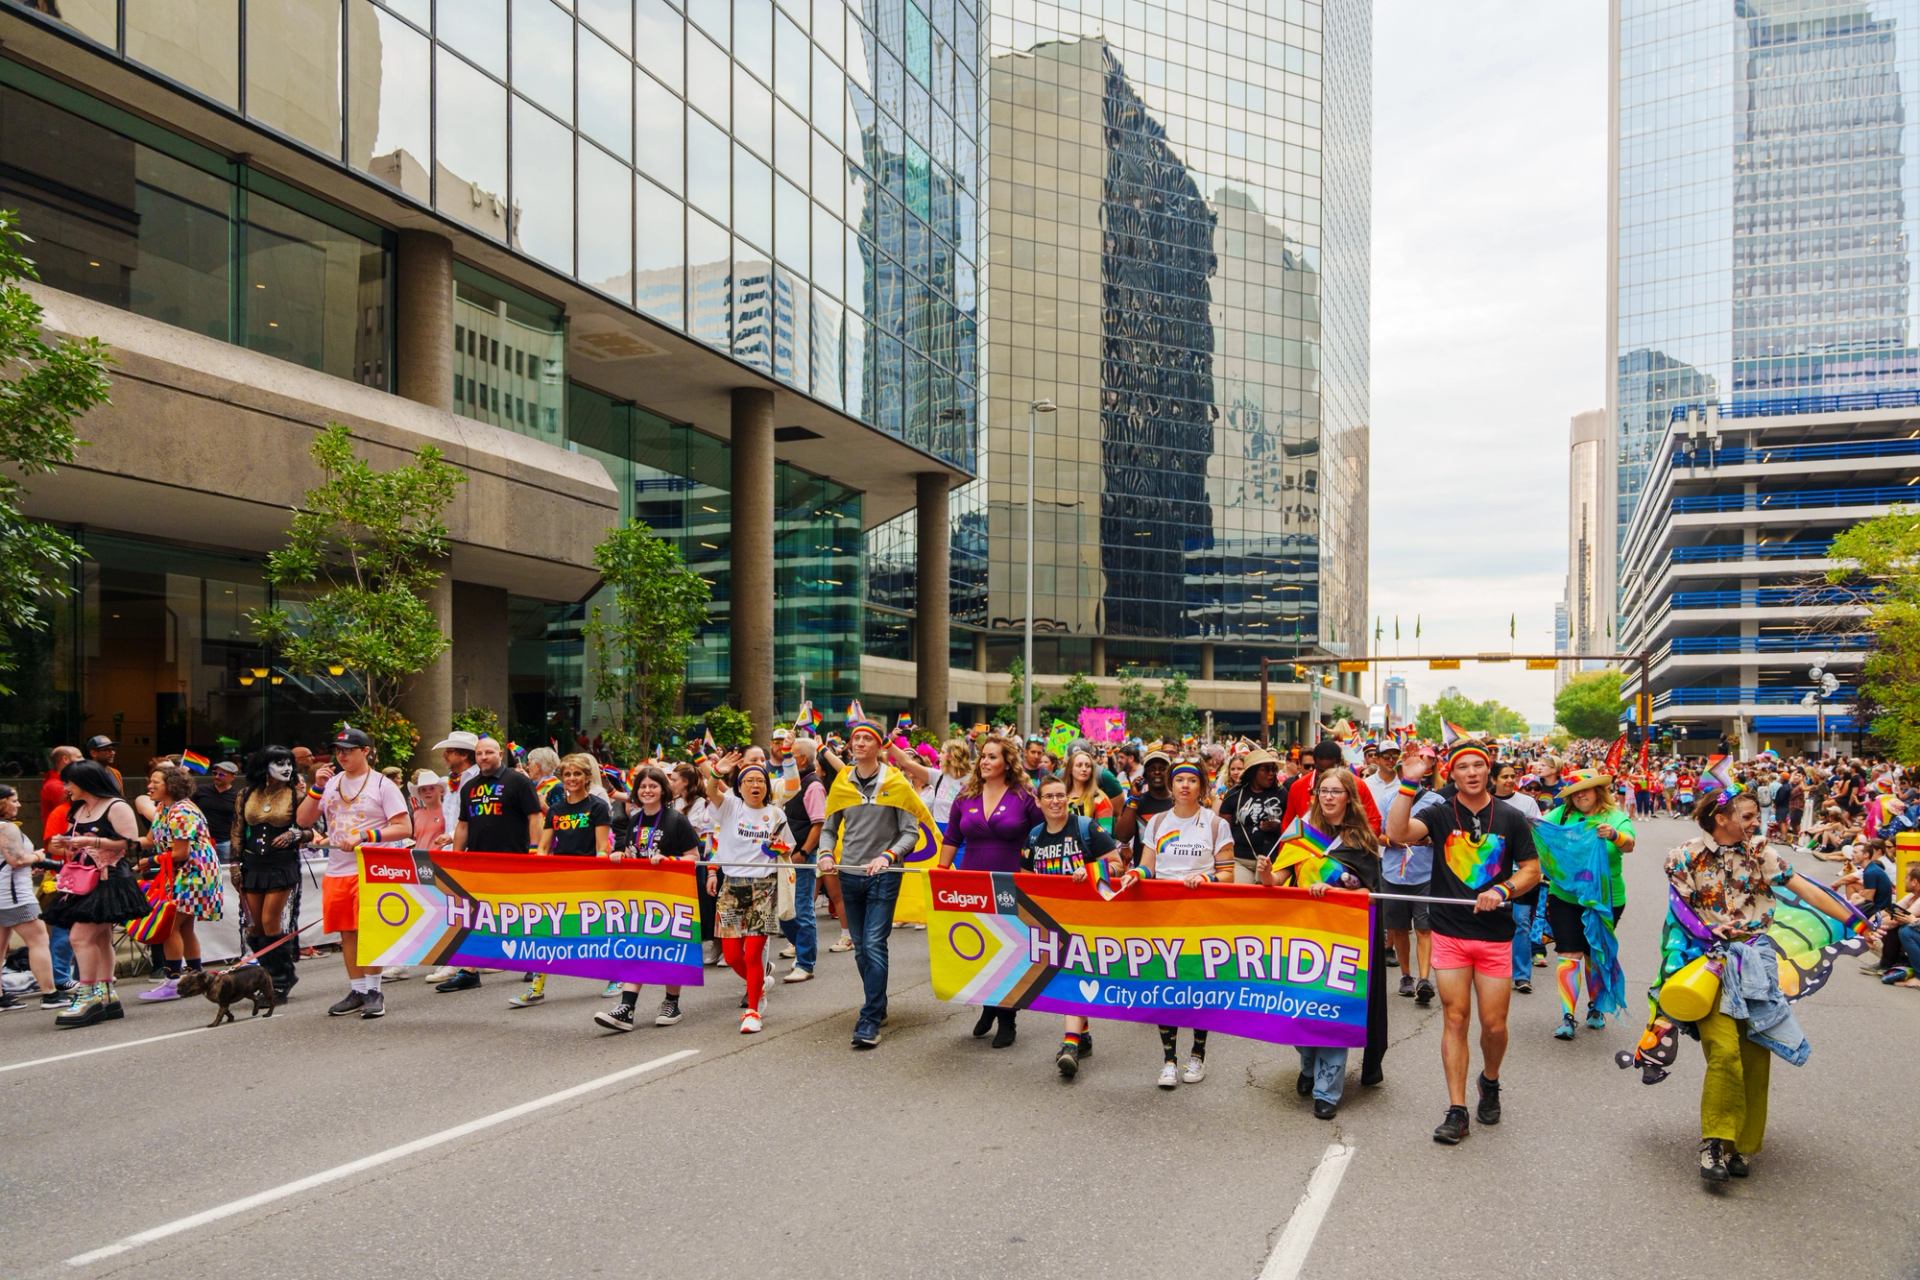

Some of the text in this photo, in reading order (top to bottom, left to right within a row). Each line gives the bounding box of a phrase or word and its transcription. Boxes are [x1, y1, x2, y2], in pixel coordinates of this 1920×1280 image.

[469, 784, 504, 798] LOVE
[482, 795, 489, 803] is
[469, 803, 502, 817] LOVE
[552, 818, 590, 830] LOVE
[1042, 844, 1062, 859] ARE
[1064, 840, 1082, 856] ALL
[370, 865, 411, 880] Calgary
[938, 890, 988, 908] Calgary
[446, 895, 695, 940] HAPPY PRIDE
[520, 938, 688, 965] Mayor and Council
[1029, 927, 1361, 993] HAPPY PRIDE
[1104, 985, 1341, 1019] City of Calgary Employees
